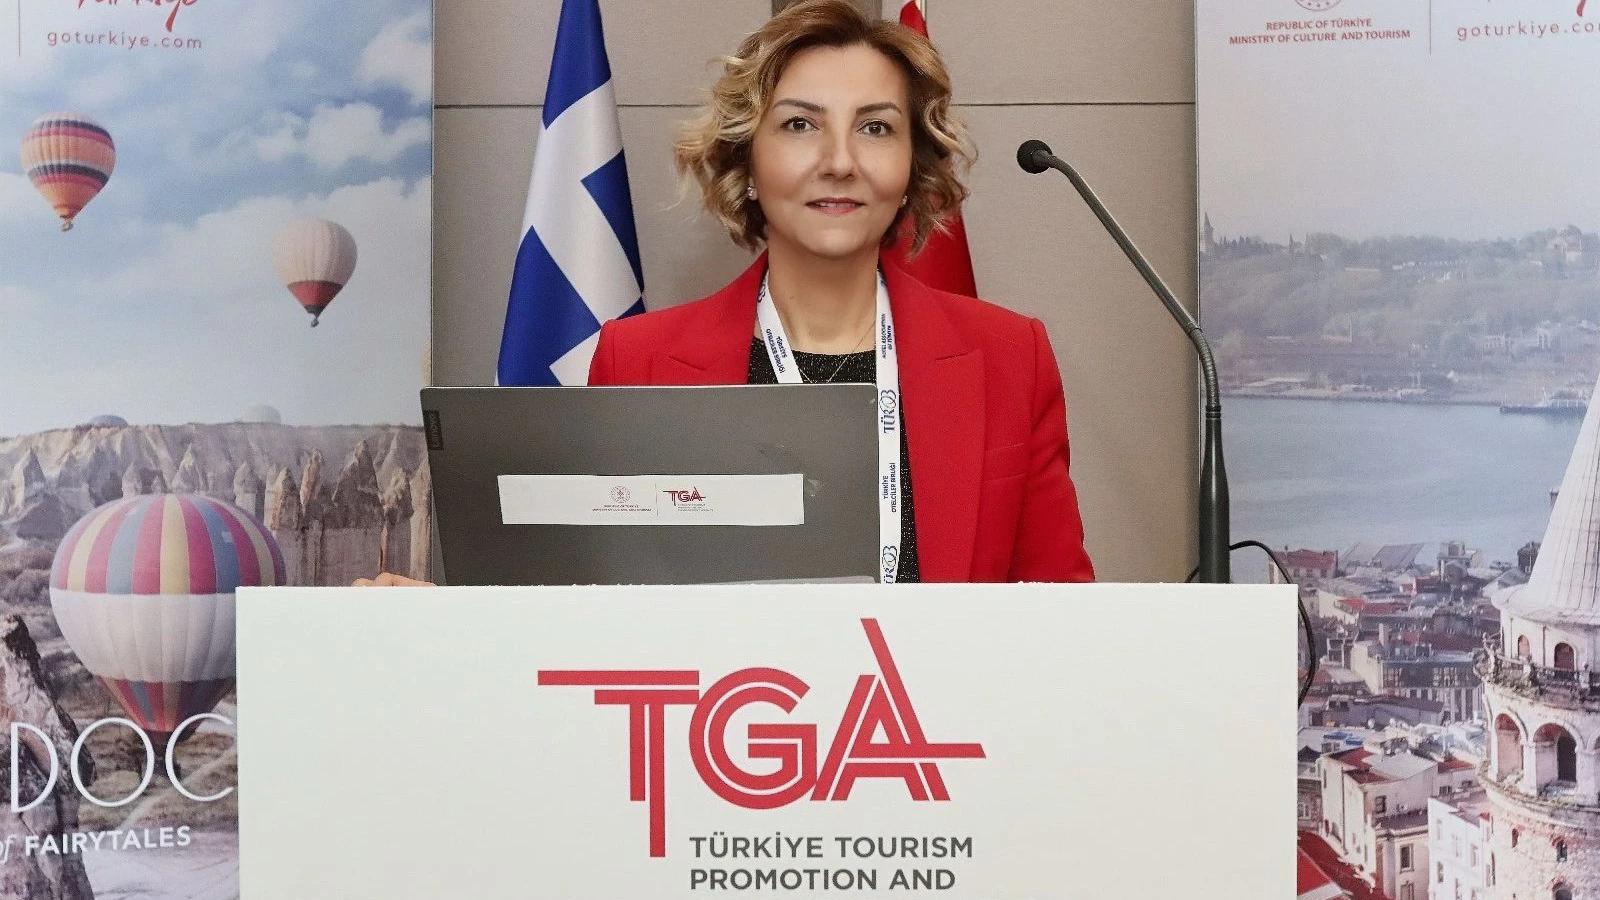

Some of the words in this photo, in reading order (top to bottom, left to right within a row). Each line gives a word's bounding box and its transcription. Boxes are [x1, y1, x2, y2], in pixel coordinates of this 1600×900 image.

[1266, 20, 1313, 31] REPUBLIC
[1315, 20, 1328, 29] OF
[1331, 17, 1372, 28] TÜRKİYE
[1456, 21, 1600, 41] goturkiye.co
[47, 30, 202, 50] goturkiye.com
[1229, 35, 1275, 45] MINISTRY
[1278, 34, 1290, 43] OF
[1293, 32, 1336, 42] CULTURE
[1341, 31, 1363, 41] AND
[1366, 29, 1411, 40] TOURISM
[663, 486, 706, 506] TGA
[537, 617, 987, 858] TGA
[25, 825, 191, 857] FAIRYTALES
[689, 830, 823, 858] TÜRKİYE
[834, 836, 973, 858] TOURISM
[690, 868, 877, 890] PROMOTION
[889, 868, 956, 890] AND
